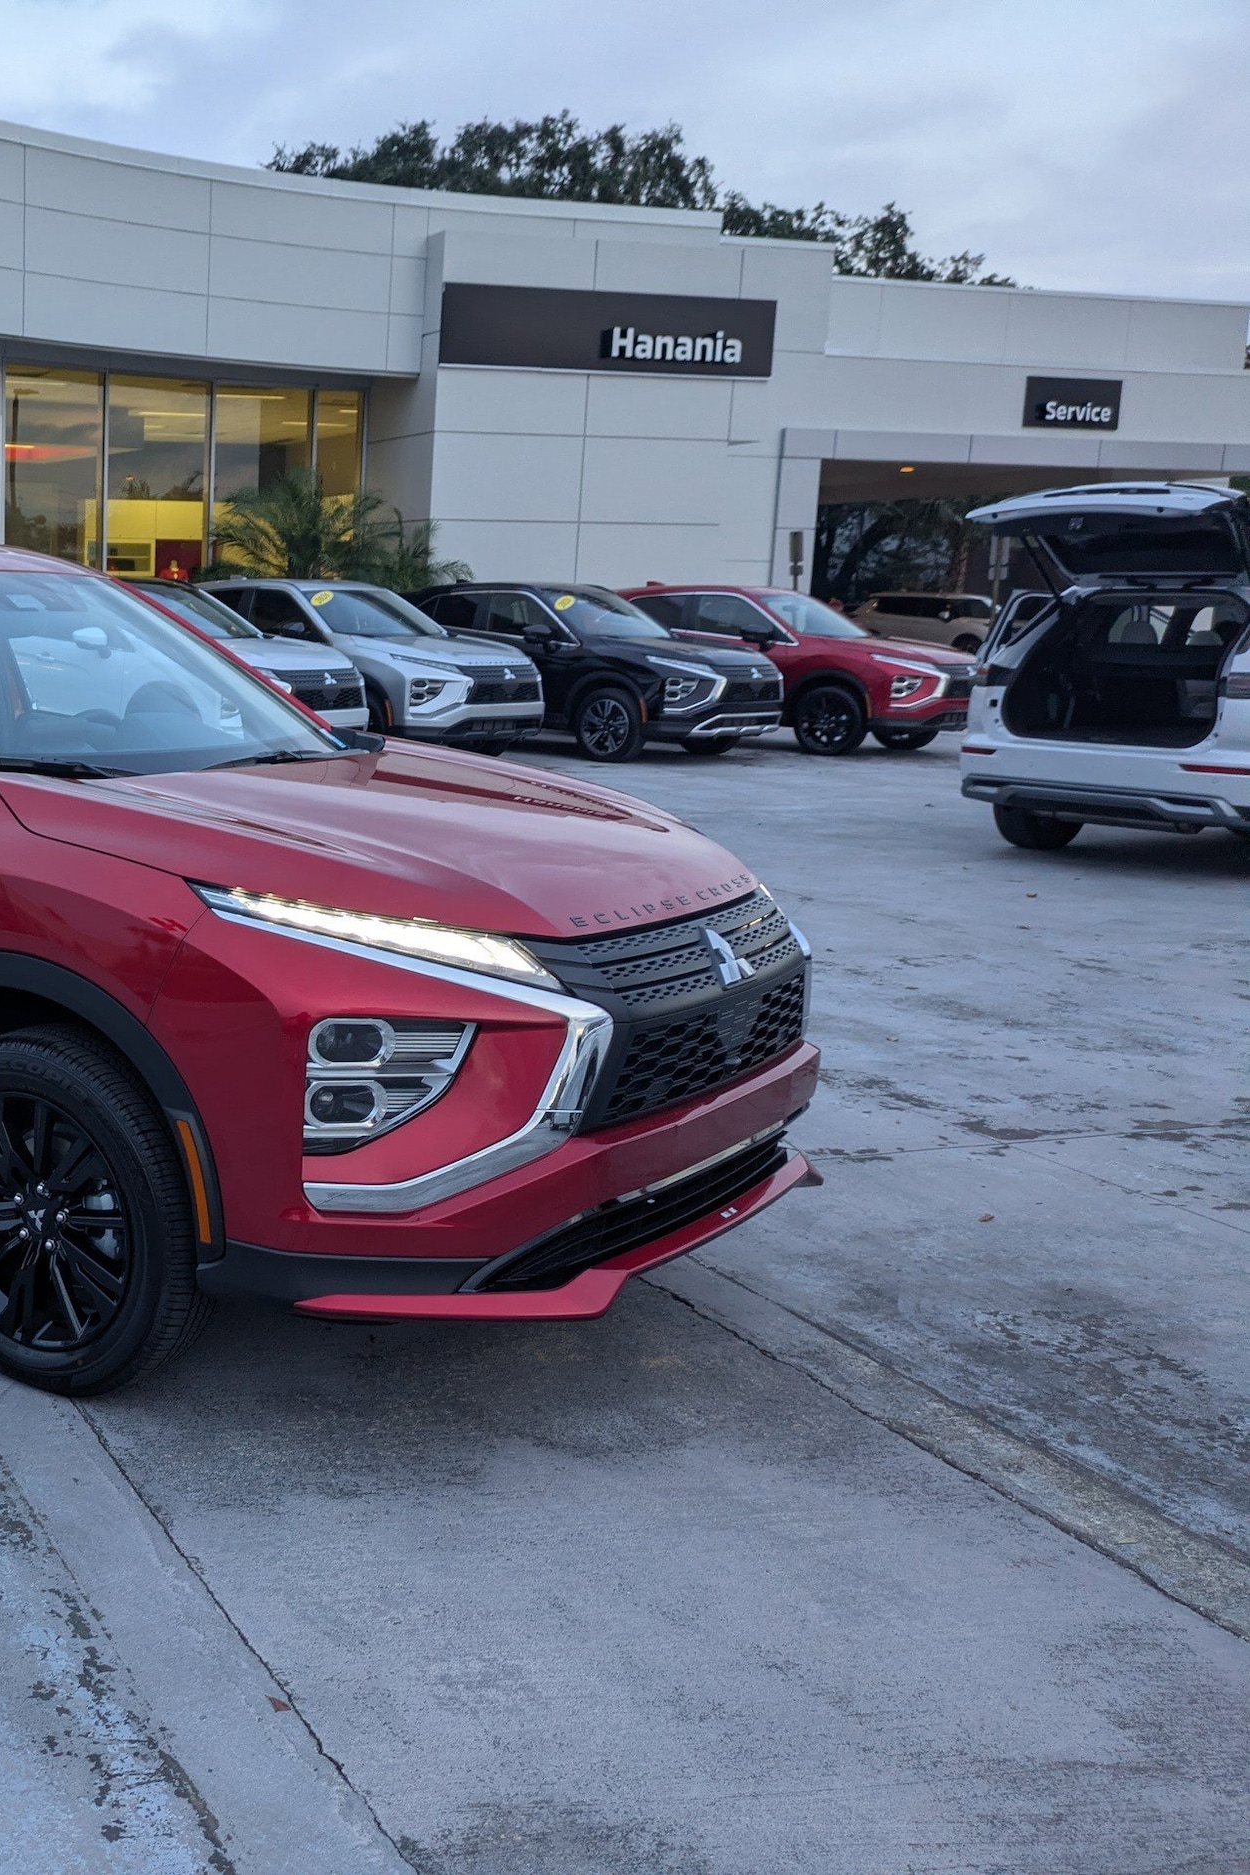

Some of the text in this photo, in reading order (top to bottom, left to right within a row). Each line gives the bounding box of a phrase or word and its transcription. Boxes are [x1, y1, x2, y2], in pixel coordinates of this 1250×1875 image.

[610, 326, 743, 364] Hanania
[1044, 400, 1112, 423] Service
[569, 873, 752, 928] ECLIPSE CROSS
